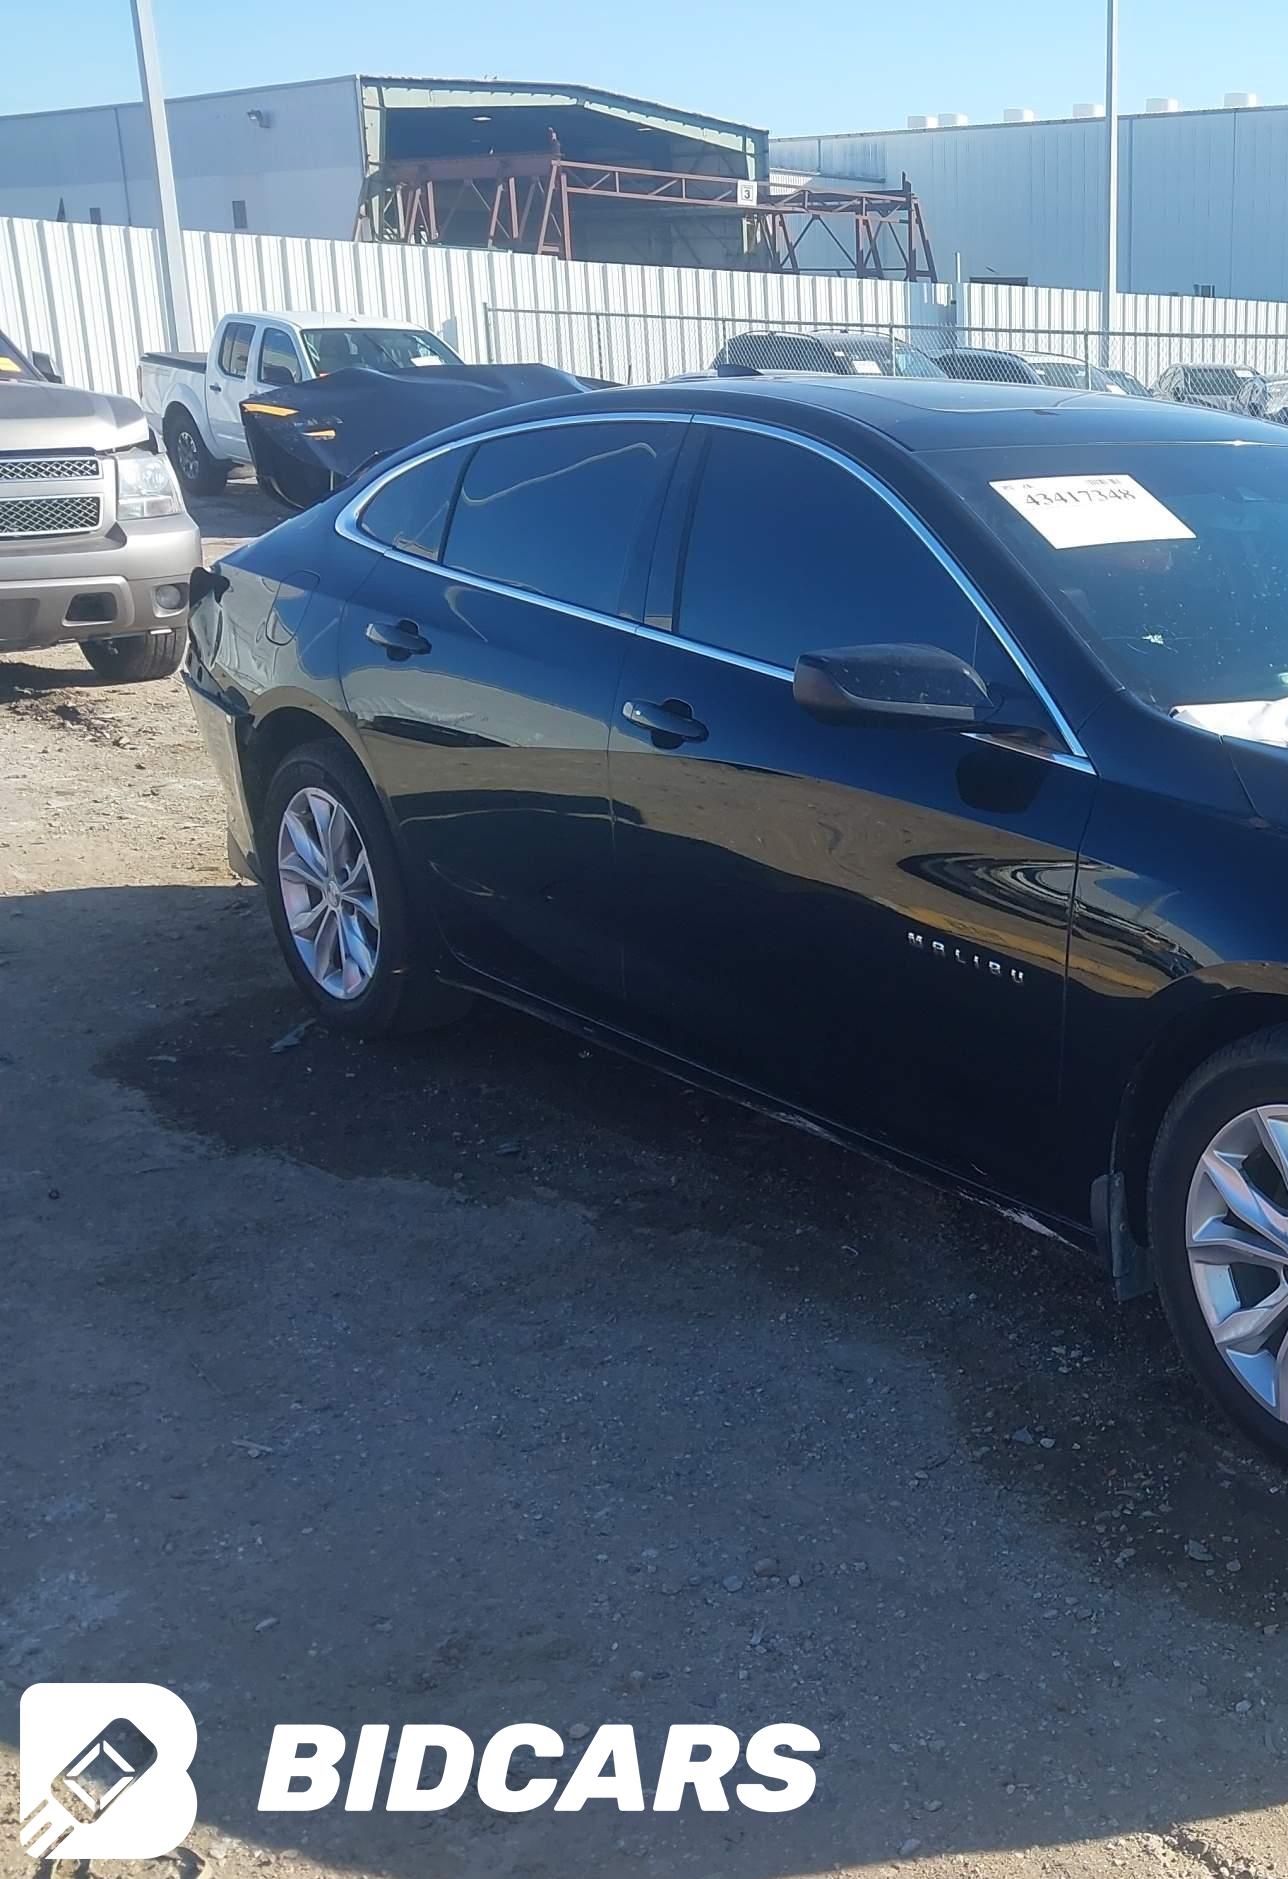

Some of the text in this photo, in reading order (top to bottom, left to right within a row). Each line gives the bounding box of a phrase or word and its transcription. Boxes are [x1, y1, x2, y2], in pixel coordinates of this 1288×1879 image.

[744, 189, 751, 200] 3
[1026, 488, 1136, 505] 43417348
[907, 931, 1025, 984] MALIBU
